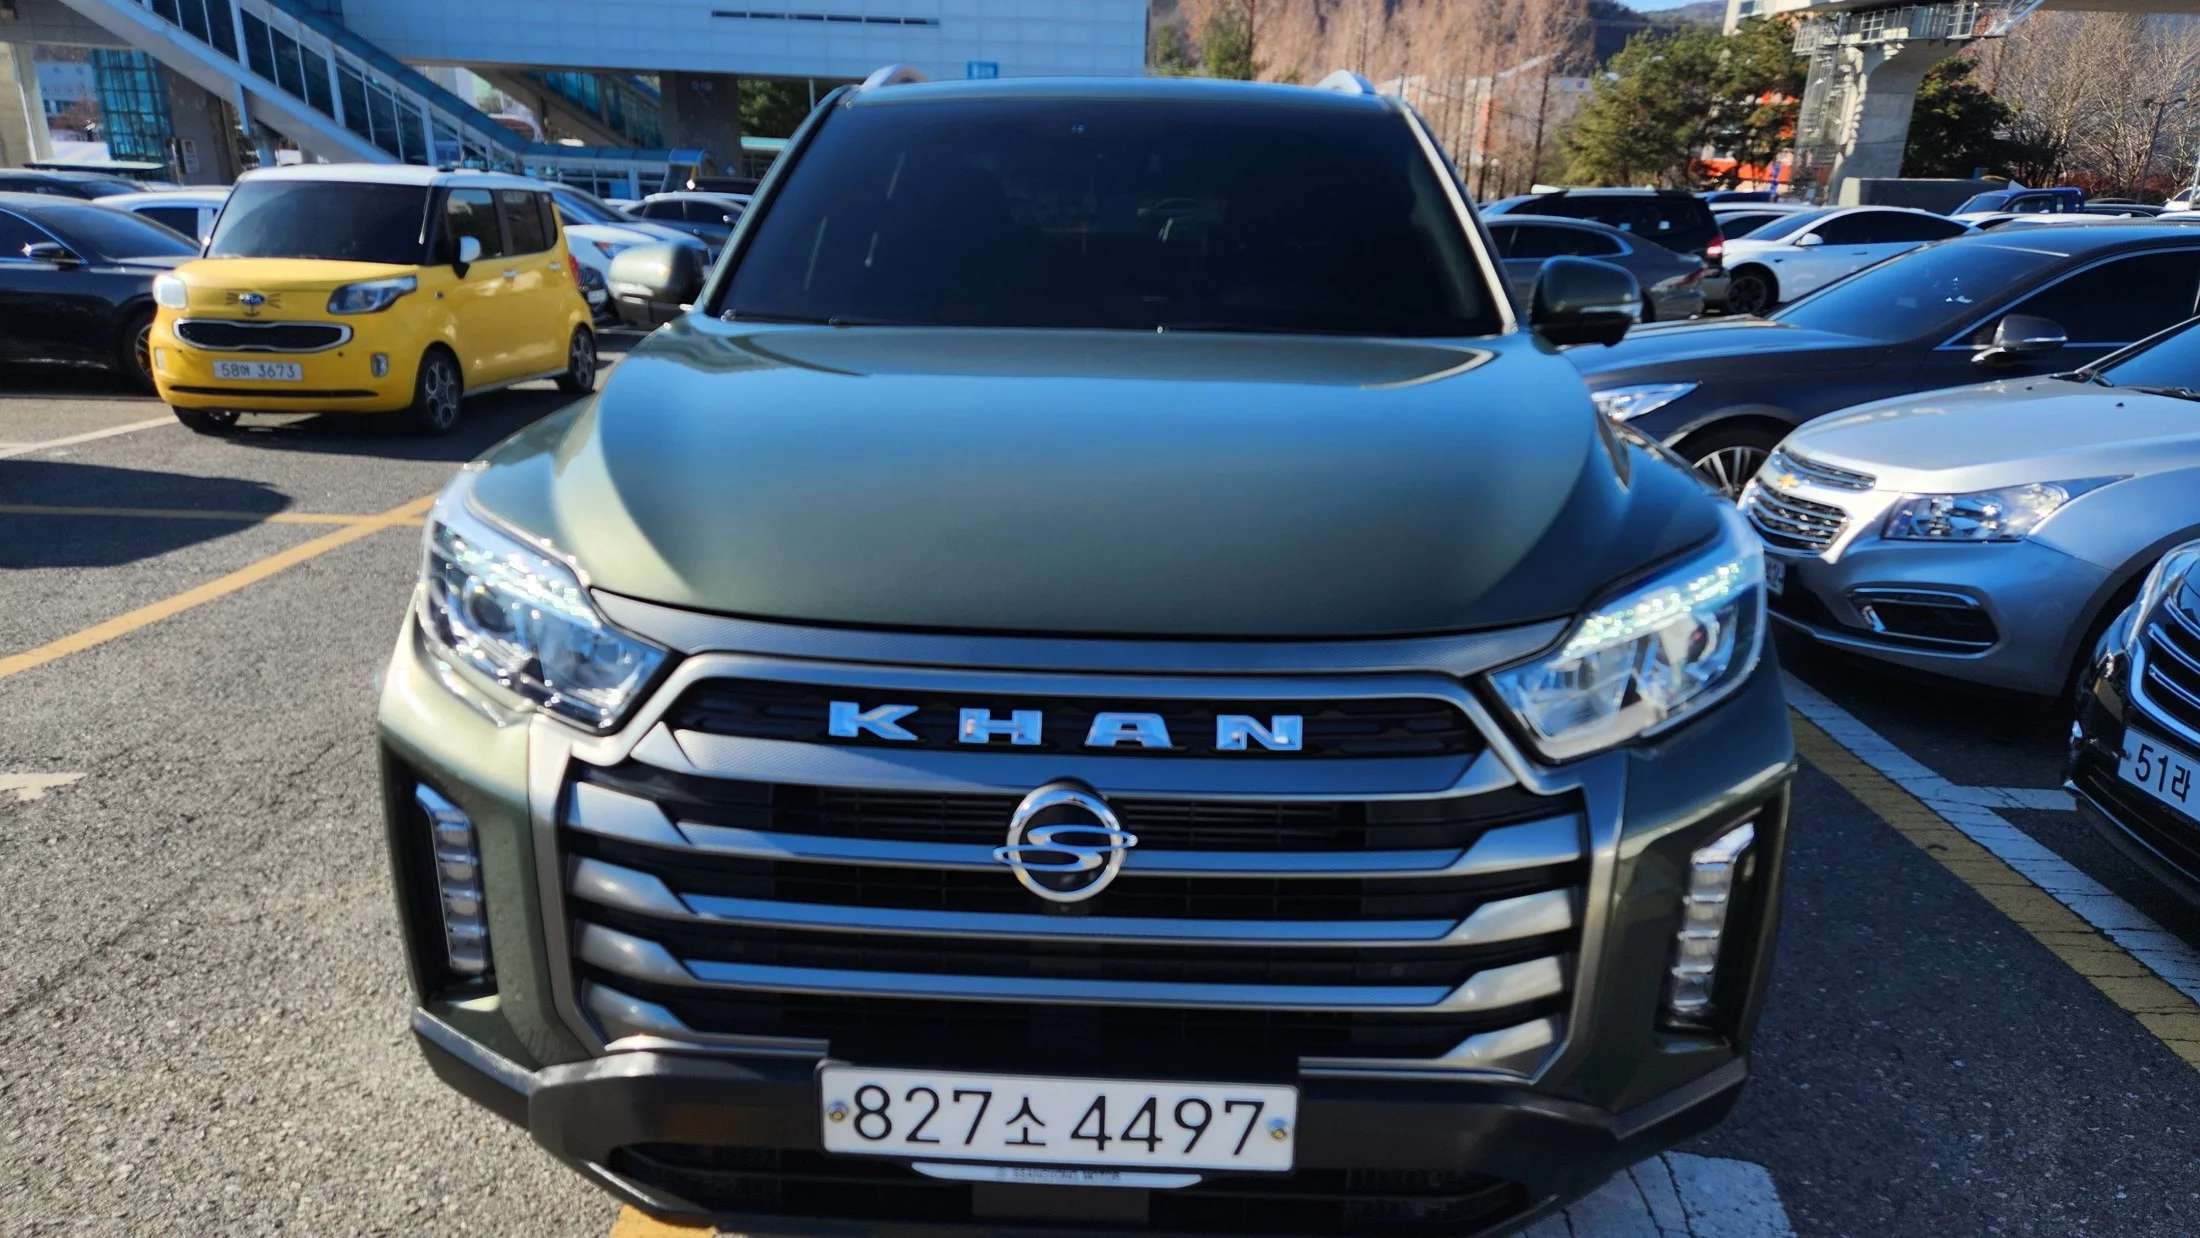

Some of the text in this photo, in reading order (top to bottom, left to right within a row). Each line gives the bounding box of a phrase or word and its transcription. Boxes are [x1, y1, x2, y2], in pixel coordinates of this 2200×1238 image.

[257, 364, 295, 378] 3673
[829, 700, 1303, 751] KHAN
[2135, 743, 2191, 803] 51라
[853, 1084, 1266, 1156] 827소 4497
